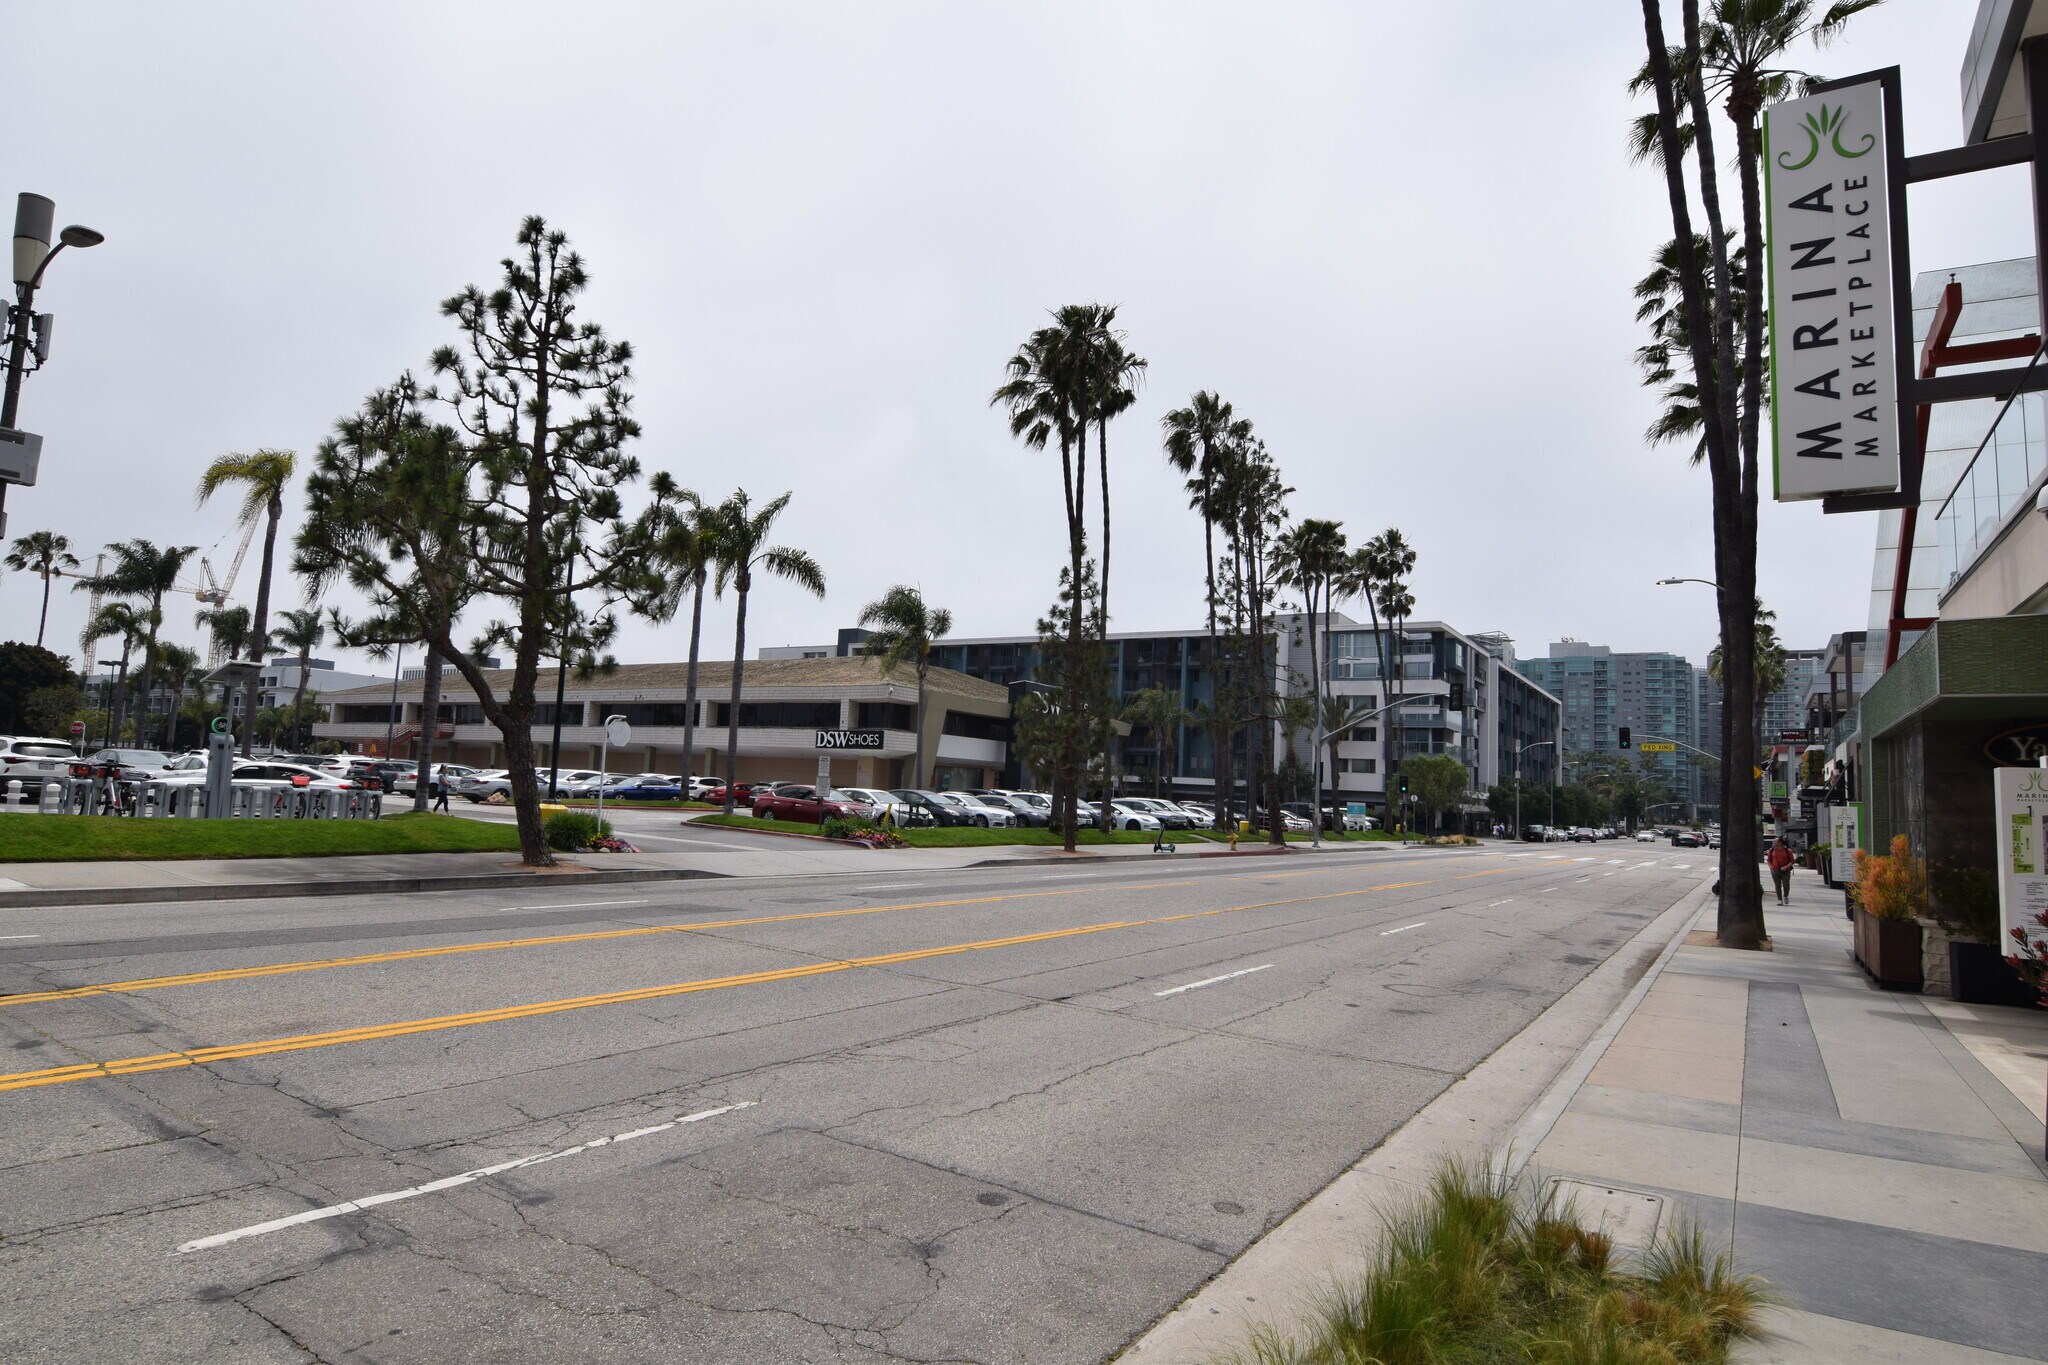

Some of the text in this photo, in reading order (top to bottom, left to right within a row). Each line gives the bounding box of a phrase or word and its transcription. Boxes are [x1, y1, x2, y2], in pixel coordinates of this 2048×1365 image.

[1788, 182, 1843, 460] MARINA
[1844, 175, 1879, 457] MARKETPLACE
[816, 731, 880, 747] DSW SHOES
[1775, 783, 1783, 792] P
